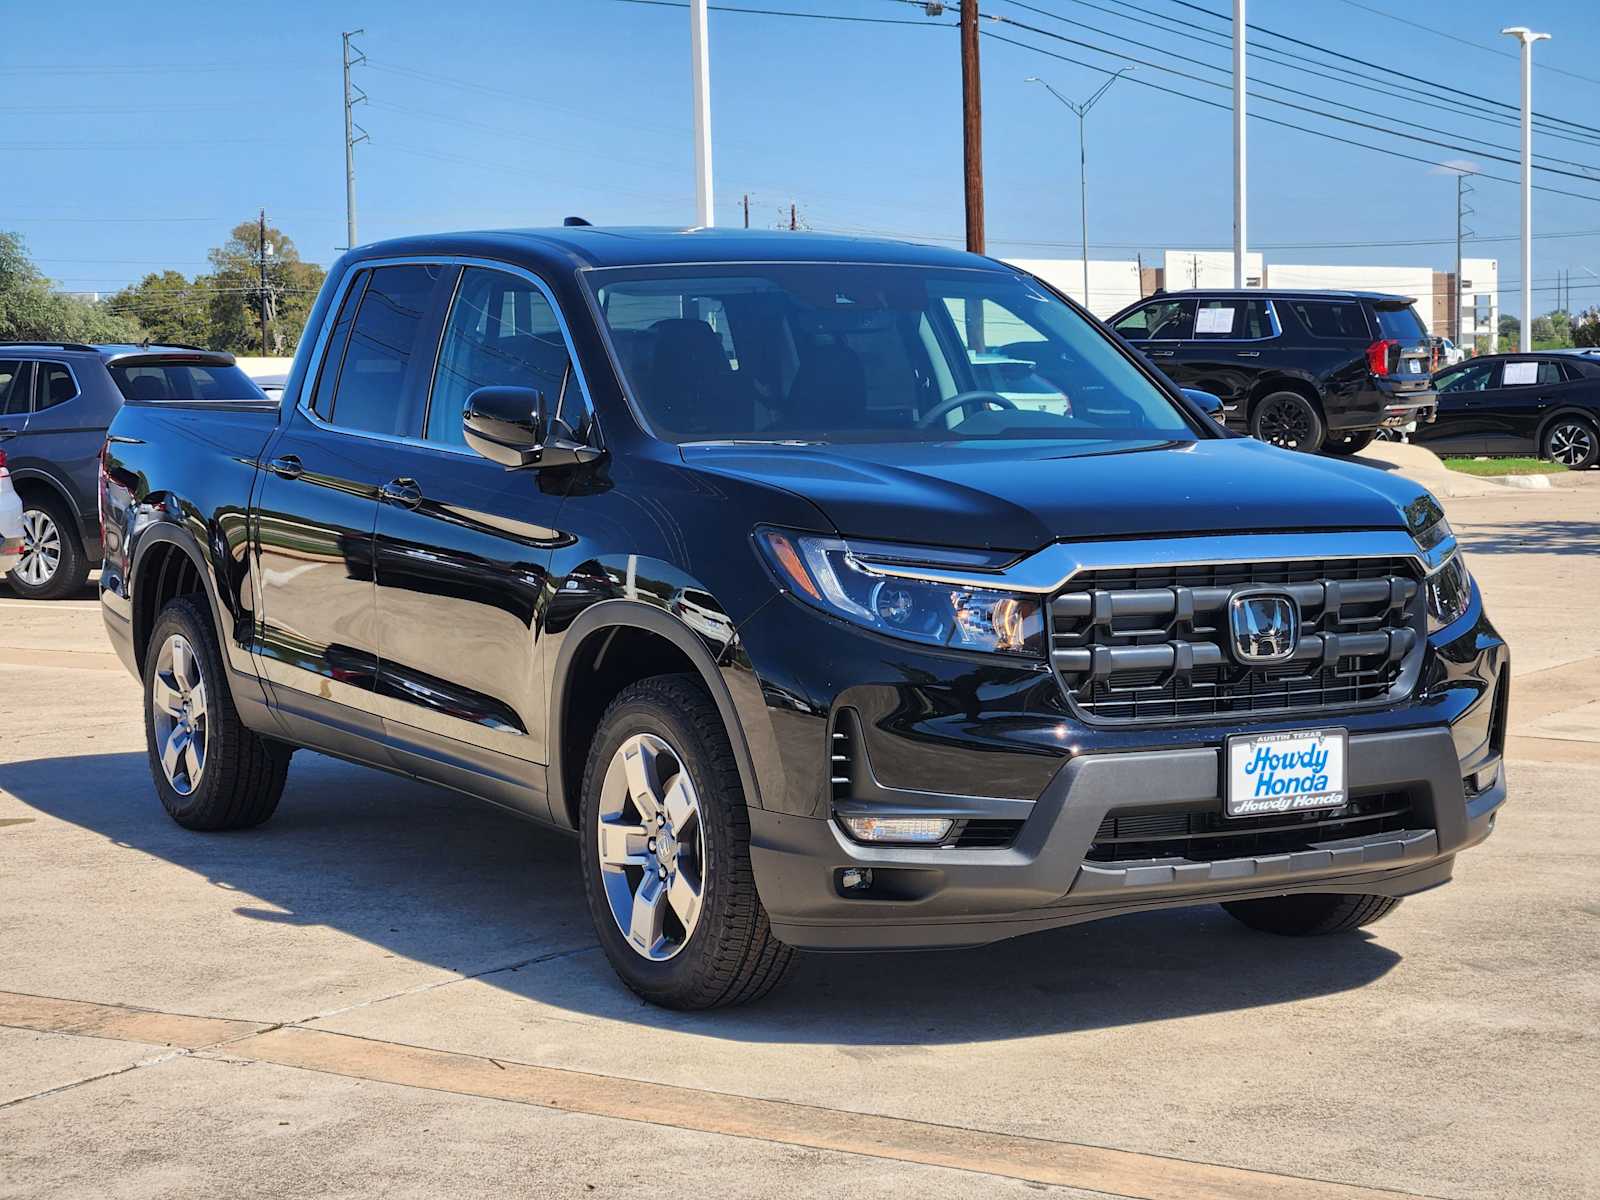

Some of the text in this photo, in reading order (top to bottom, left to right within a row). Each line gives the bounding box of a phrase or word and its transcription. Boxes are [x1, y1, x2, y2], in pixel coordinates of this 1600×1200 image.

[1257, 731, 1322, 742] AUSTIN TEXAS
[1245, 743, 1329, 774] Howdy
[1254, 773, 1328, 796] Honda
[1234, 793, 1344, 813] Howdy Honda
